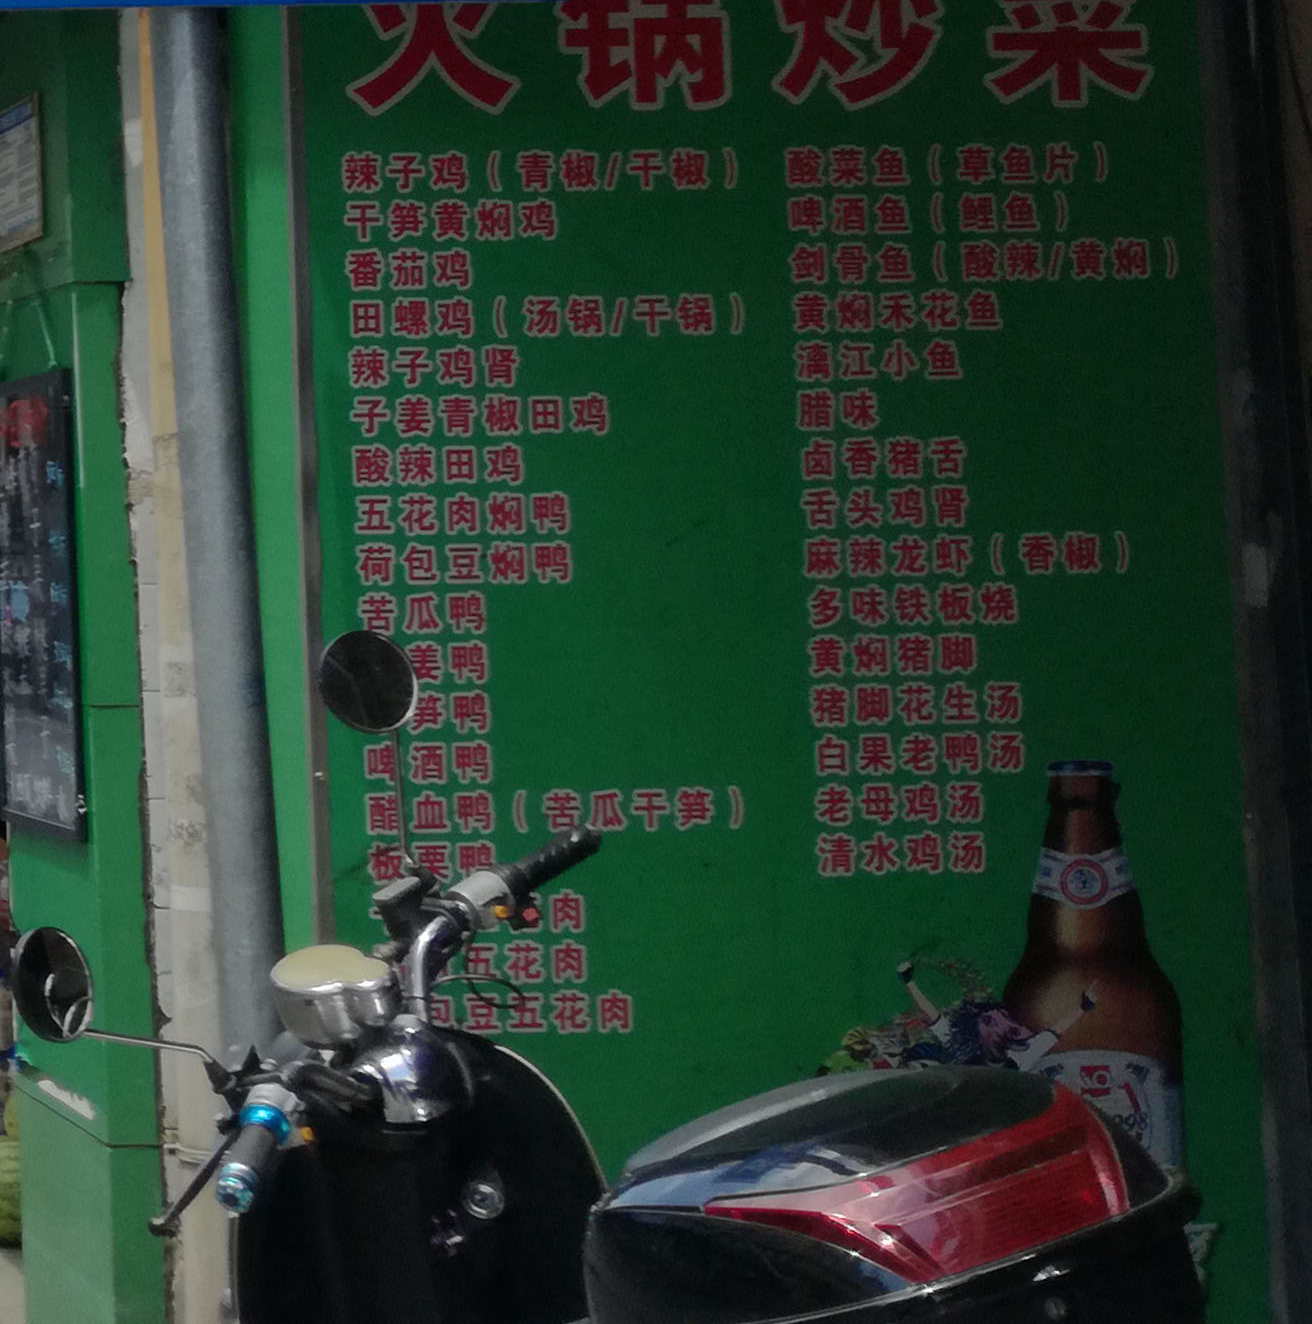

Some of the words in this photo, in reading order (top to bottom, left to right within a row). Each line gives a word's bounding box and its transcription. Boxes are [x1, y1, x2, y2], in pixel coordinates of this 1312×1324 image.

[346, 201, 558, 240] 干笋黄焖鸡
[348, 249, 472, 290] 番茄鸡
[794, 291, 1001, 331] 黄焖禾花鱼
[351, 345, 519, 386] 辣子鸡肾
[796, 340, 963, 381] 漓江小鱼
[351, 393, 609, 436] 子姜青椒田鸡
[799, 389, 879, 429] 腊味
[353, 444, 523, 484] 酸辣田鸡
[802, 437, 966, 478] 卤香猪舌
[355, 492, 569, 533] 五花肉焖鸭
[804, 486, 970, 529] 舌头鸡肾
[359, 542, 571, 583] 荷包豆焖鸭
[360, 592, 486, 634] 苦瓜鸭
[808, 583, 1017, 627] 多味铁板烧
[403, 642, 490, 683] 姜鸭
[810, 634, 976, 675] 黄焖猪脚
[405, 692, 492, 734] 笋鸭
[812, 682, 1022, 725] 猪脚花生汤
[363, 742, 493, 783] 啤酒鸭
[816, 730, 1024, 775] 白果老鸭汤
[816, 782, 985, 827] 老母鸡汤
[818, 831, 986, 876] 清水鸡汤
[423, 989, 634, 1035] 包豆五花肉
